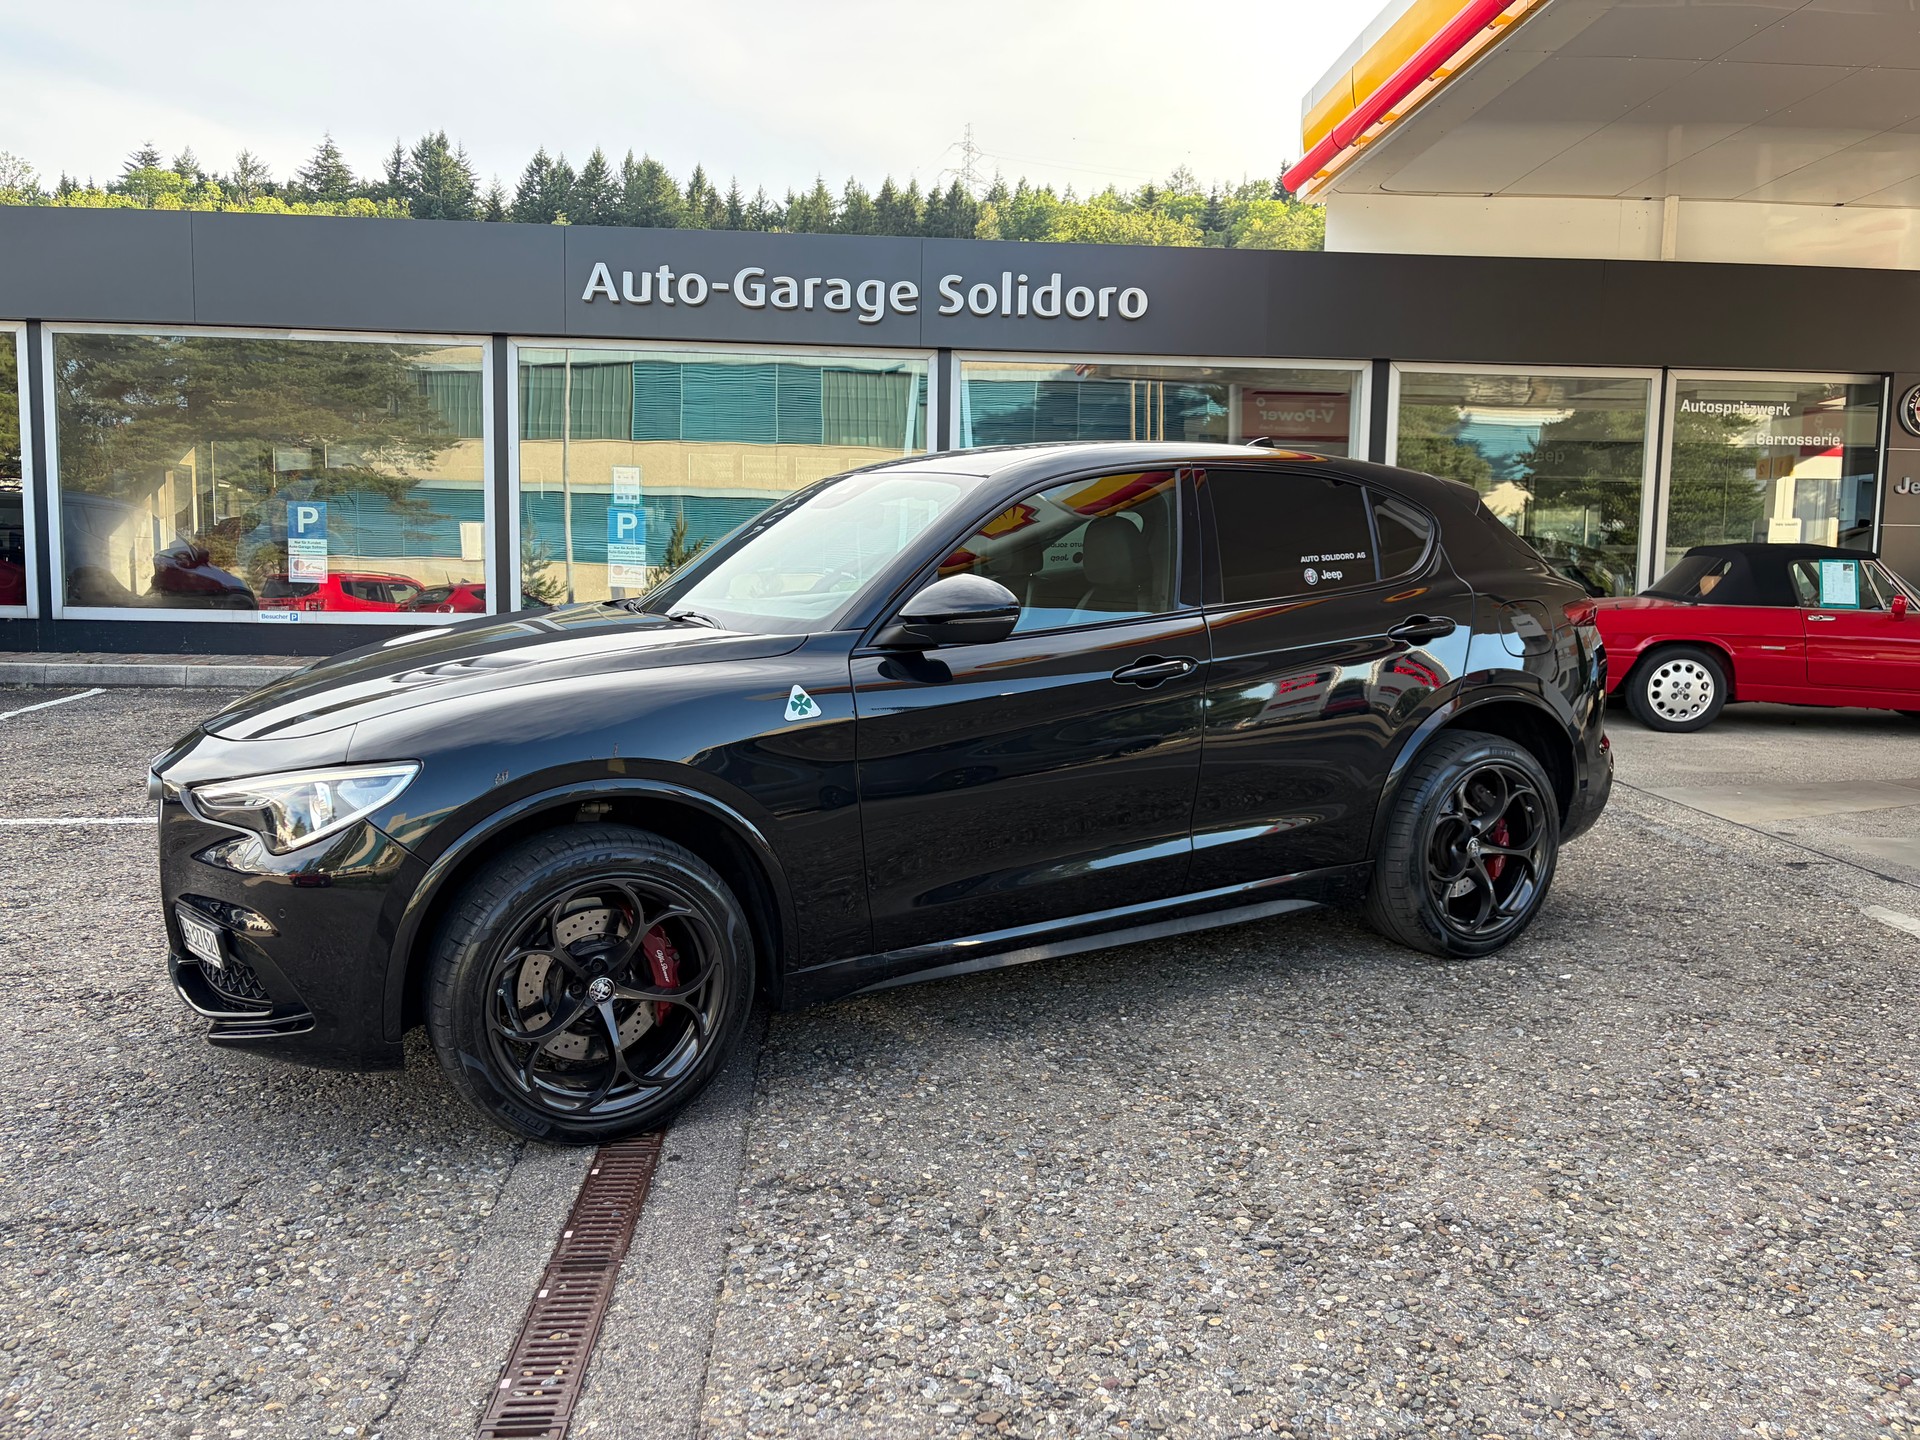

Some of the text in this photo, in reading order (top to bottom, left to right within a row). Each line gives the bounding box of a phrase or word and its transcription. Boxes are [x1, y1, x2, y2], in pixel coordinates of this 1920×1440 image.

[582, 261, 1149, 325] Auto-Garage Solidoro
[1680, 399, 1791, 417] Autospritzwerk
[1756, 433, 1841, 446] Carrosserie
[297, 506, 319, 533] P
[617, 512, 638, 539] P
[1300, 551, 1366, 563] AUTO SOLIDORO AG
[1321, 569, 1343, 581] Jeep
